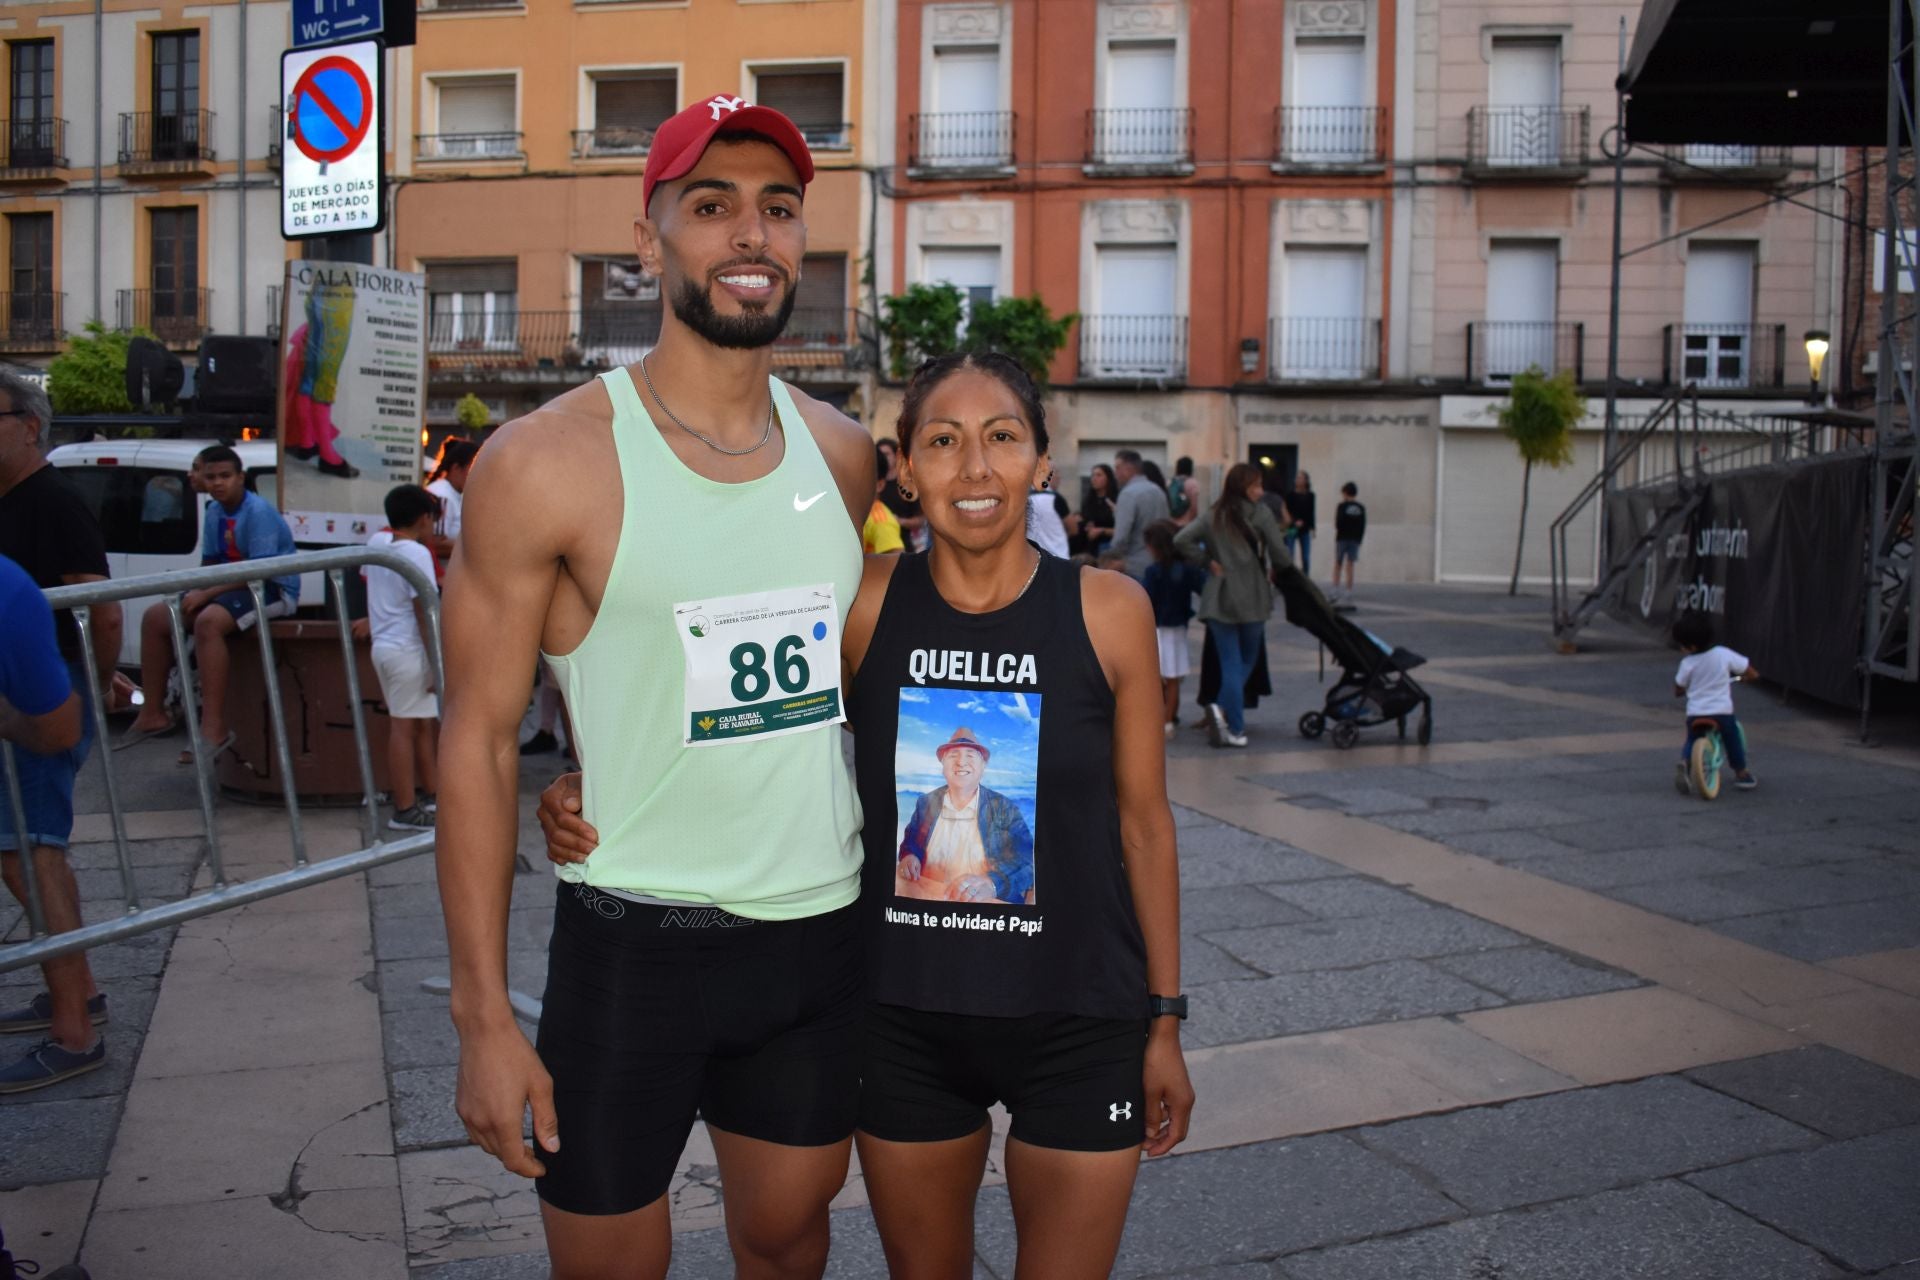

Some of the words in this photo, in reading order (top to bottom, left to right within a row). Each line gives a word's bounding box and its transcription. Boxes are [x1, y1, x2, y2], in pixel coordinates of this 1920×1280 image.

[301, 20, 330, 40] WC
[288, 184, 329, 199] JUEVES
[334, 183, 342, 193] O
[347, 178, 374, 192] DÍAS
[292, 202, 307, 212] DE
[312, 195, 369, 210] MERCADO
[294, 216, 308, 226] DE
[314, 214, 327, 224] 07
[333, 213, 340, 222] A
[346, 211, 356, 221] 15
[298, 267, 417, 297] CALAHORRA
[1244, 413, 1430, 427] RESTAURANTE
[715, 617, 739, 626] CARRERA
[740, 614, 760, 622] CIUDAD
[776, 609, 796, 617] VERDURA
[804, 604, 830, 613] CALAHORRA
[730, 635, 810, 702] 86
[909, 649, 1037, 684] QUELLCA
[719, 715, 737, 723] CAJA
[738, 712, 761, 721] RURAL
[731, 718, 765, 729] NAVARRA
[885, 907, 920, 926] Nunca
[923, 912, 938, 927] te
[942, 912, 1005, 932] olvidaré
[1009, 916, 1043, 937] Papá
